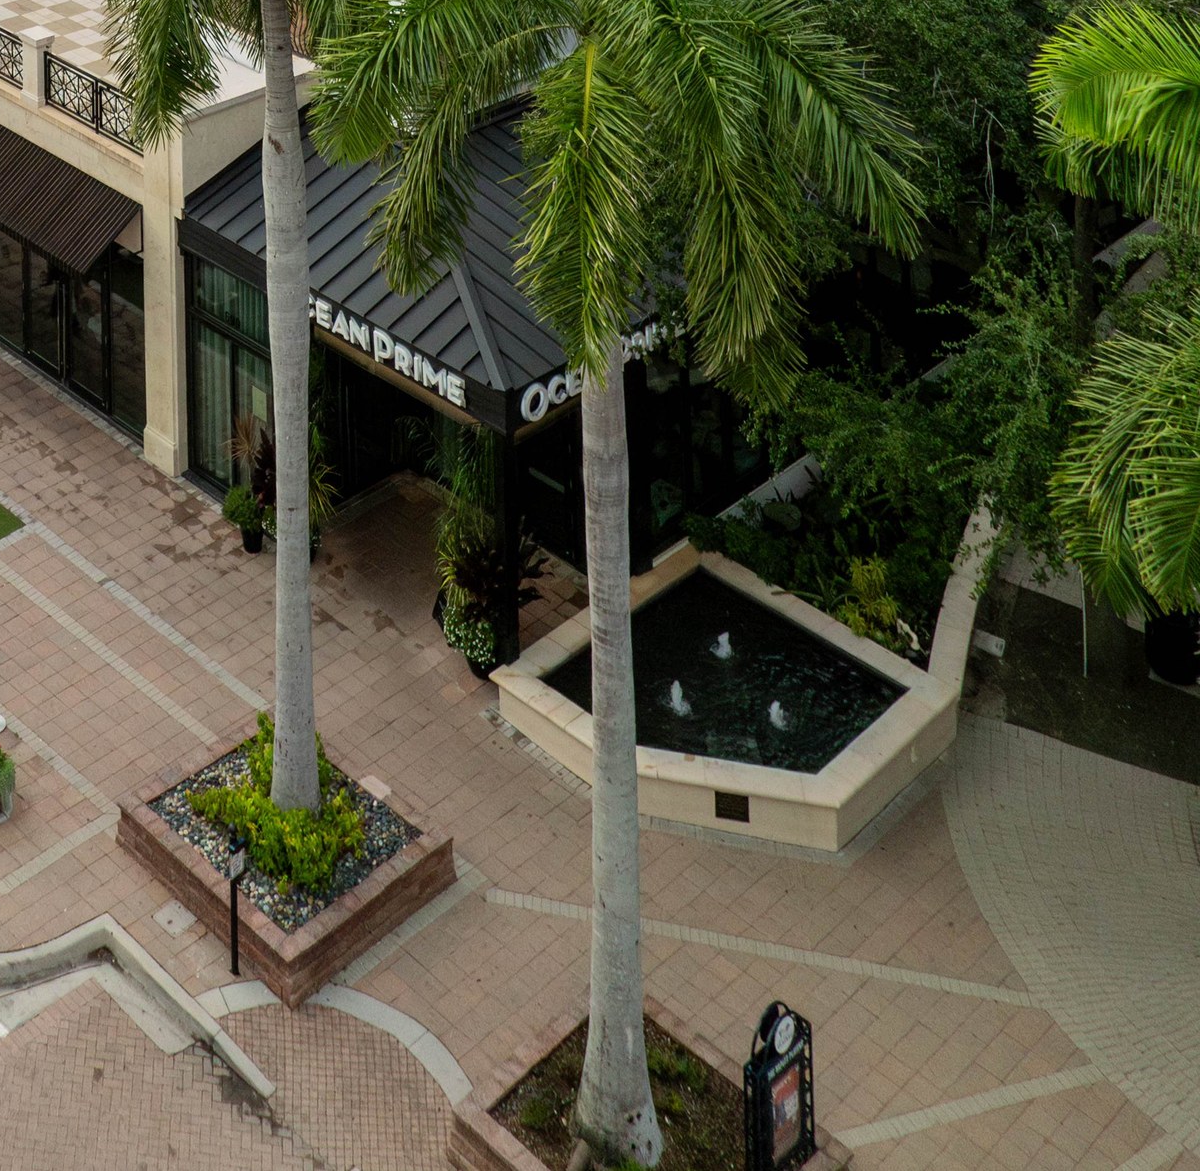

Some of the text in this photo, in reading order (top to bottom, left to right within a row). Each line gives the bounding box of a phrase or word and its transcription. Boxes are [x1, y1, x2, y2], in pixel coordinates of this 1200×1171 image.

[309, 292, 467, 409] EAN PRIME
[520, 368, 583, 422] OCE
